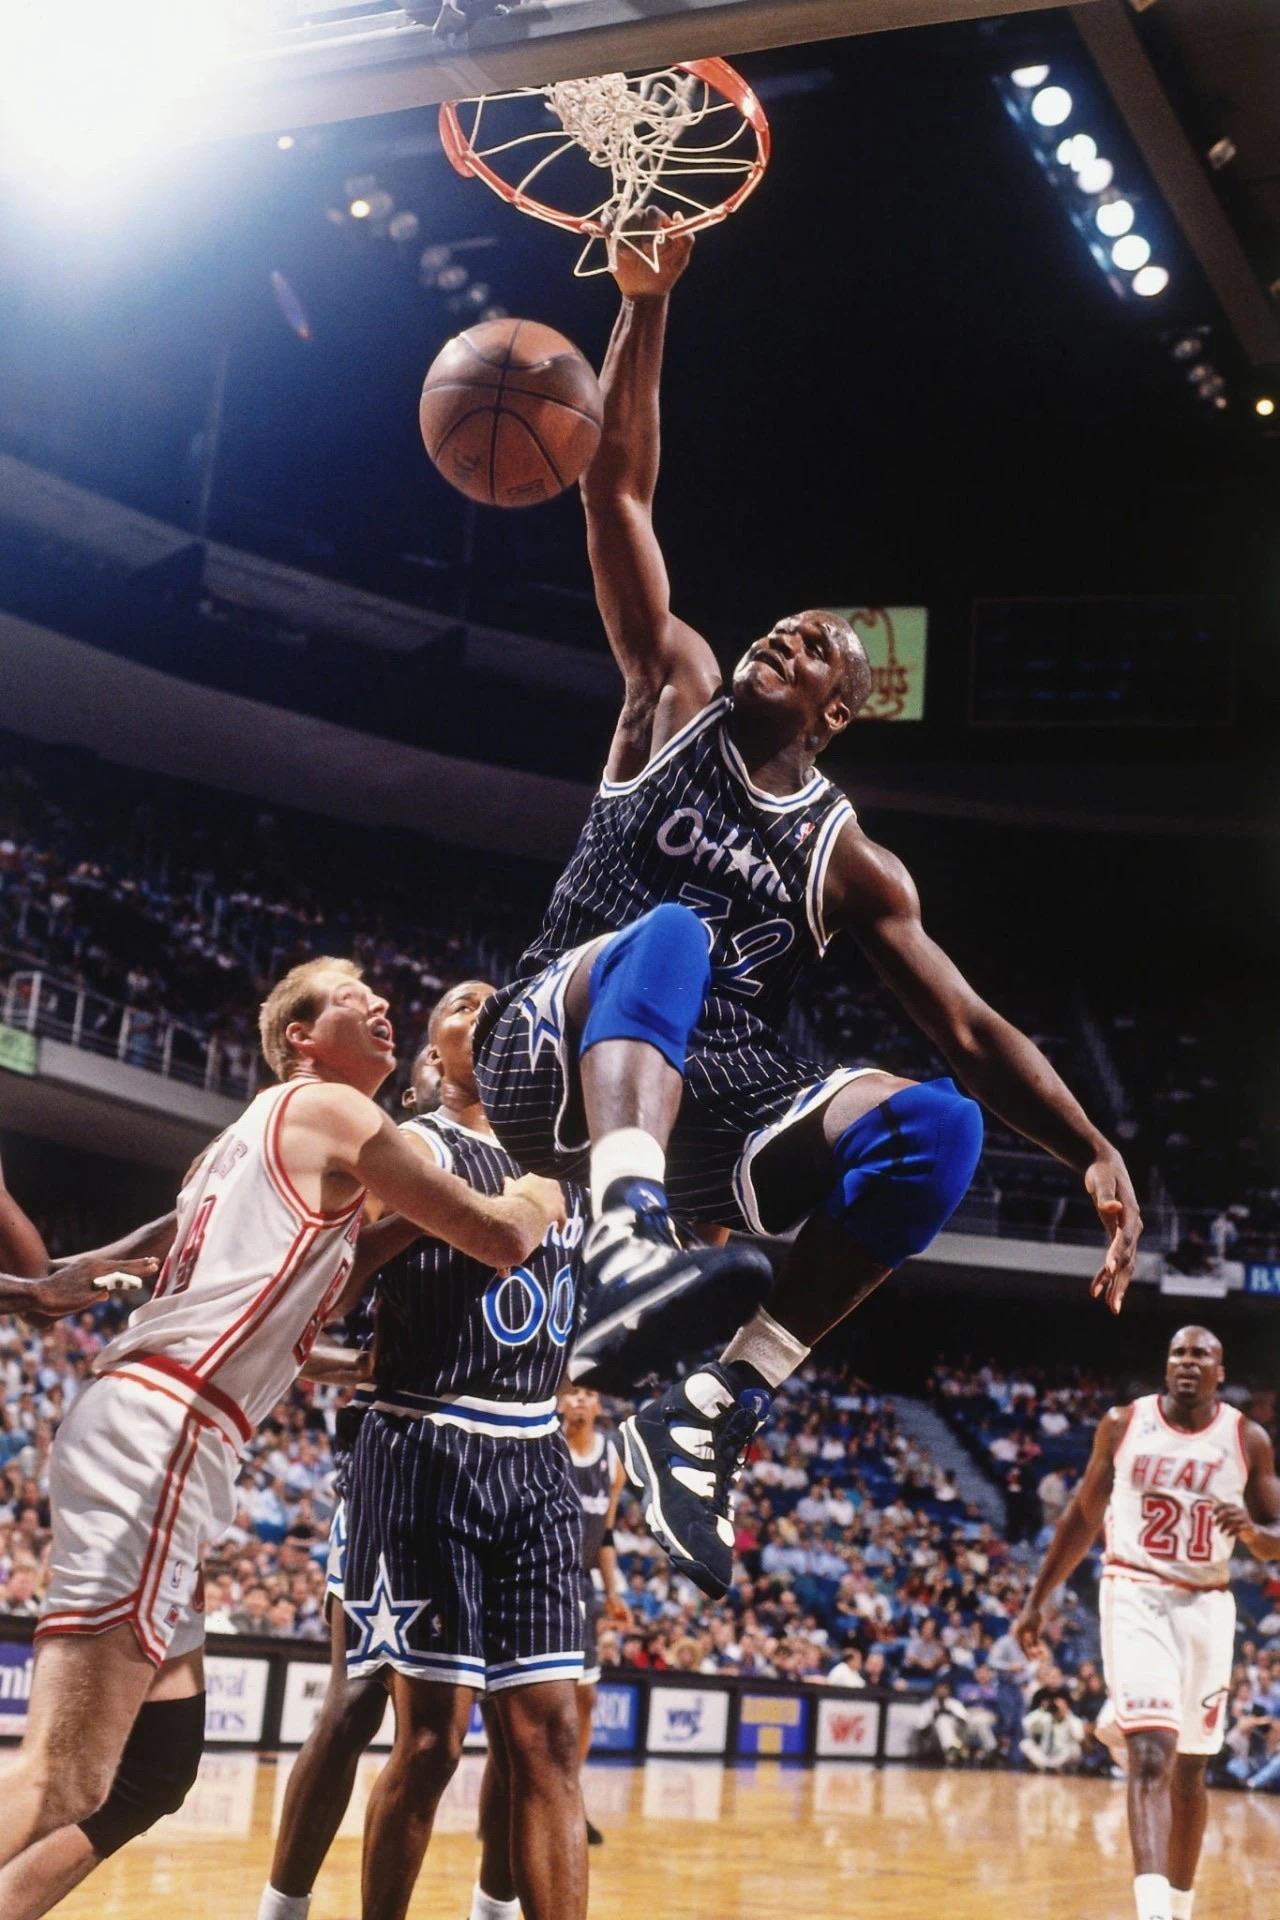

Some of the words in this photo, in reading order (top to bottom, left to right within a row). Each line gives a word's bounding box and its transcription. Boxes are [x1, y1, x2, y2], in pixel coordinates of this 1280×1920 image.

[481, 1264, 575, 1346] 00
[1131, 1454, 1222, 1495] HEAT
[1140, 1493, 1216, 1562] 21
